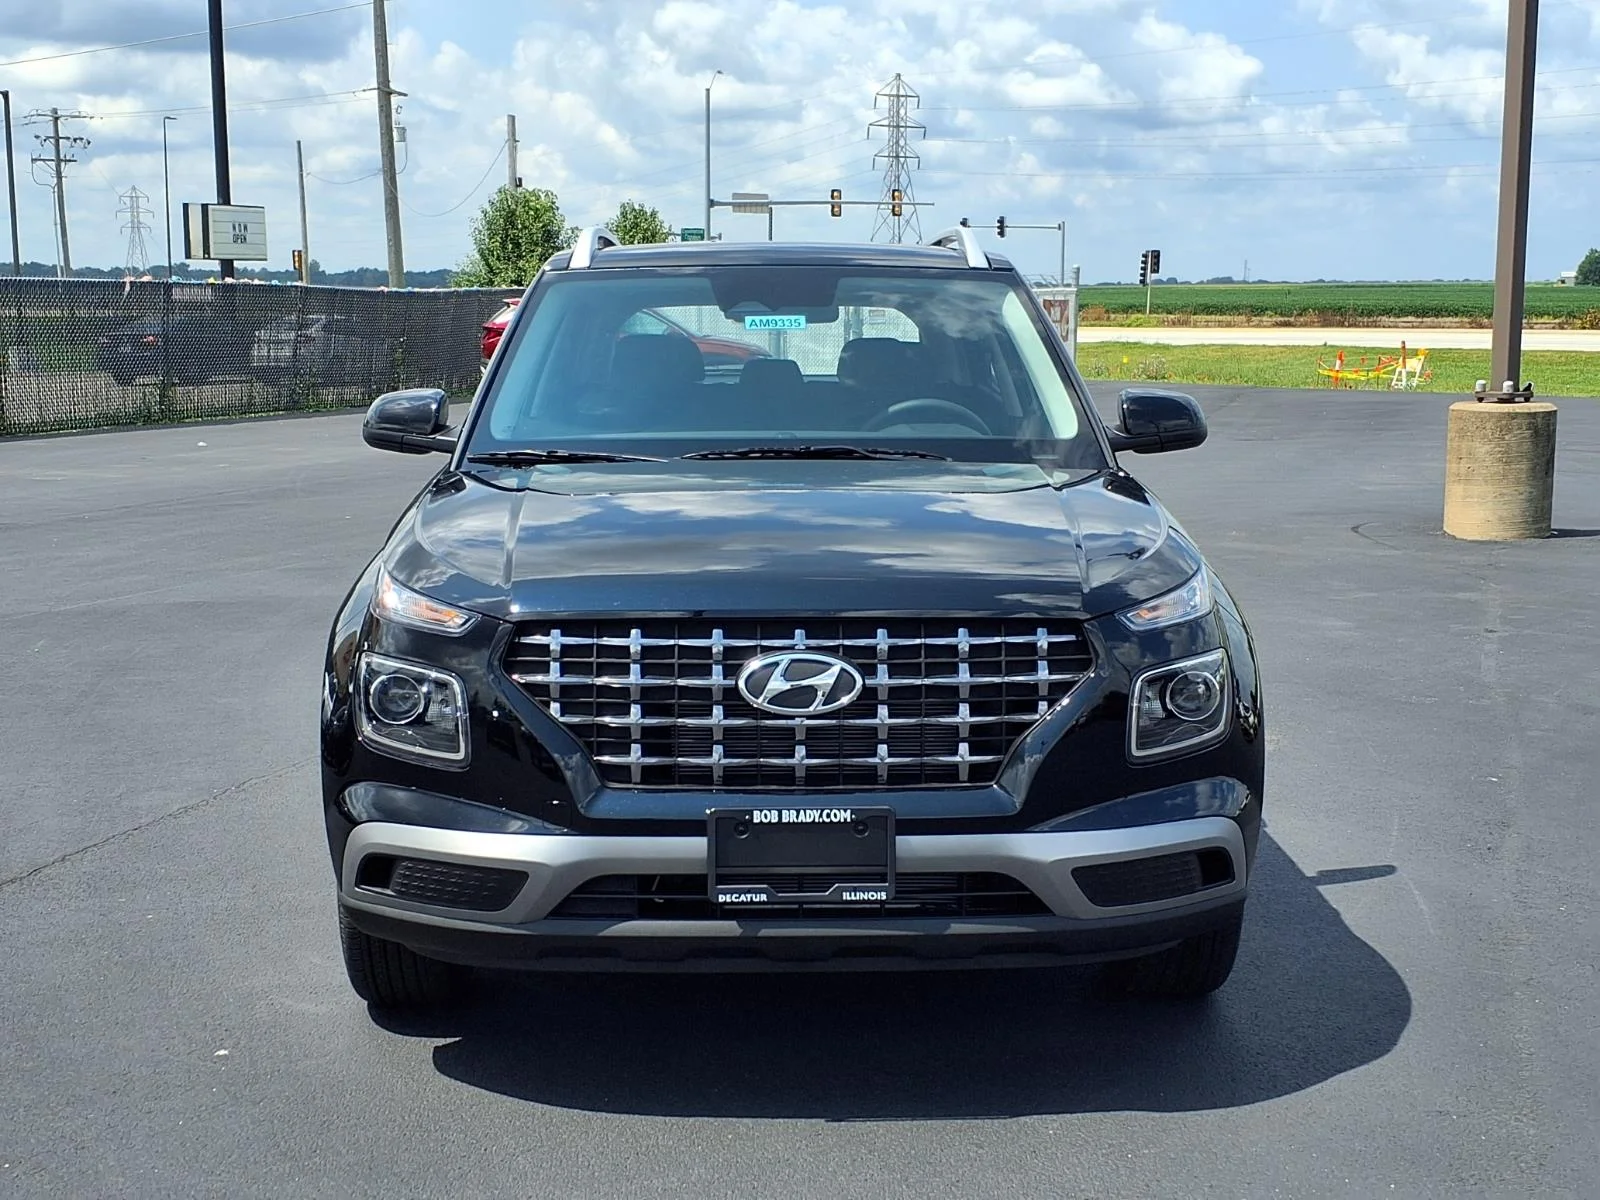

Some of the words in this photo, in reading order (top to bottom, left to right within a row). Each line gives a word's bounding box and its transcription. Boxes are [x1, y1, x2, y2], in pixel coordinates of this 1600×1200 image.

[232, 222, 248, 233] NOW
[233, 234, 247, 243] OPEN
[749, 318, 801, 328] AM9335
[753, 810, 778, 823] BOB
[782, 809, 852, 823] BRADY.COM
[718, 893, 768, 902] DECATUR
[842, 891, 887, 900] ILLINOIS
